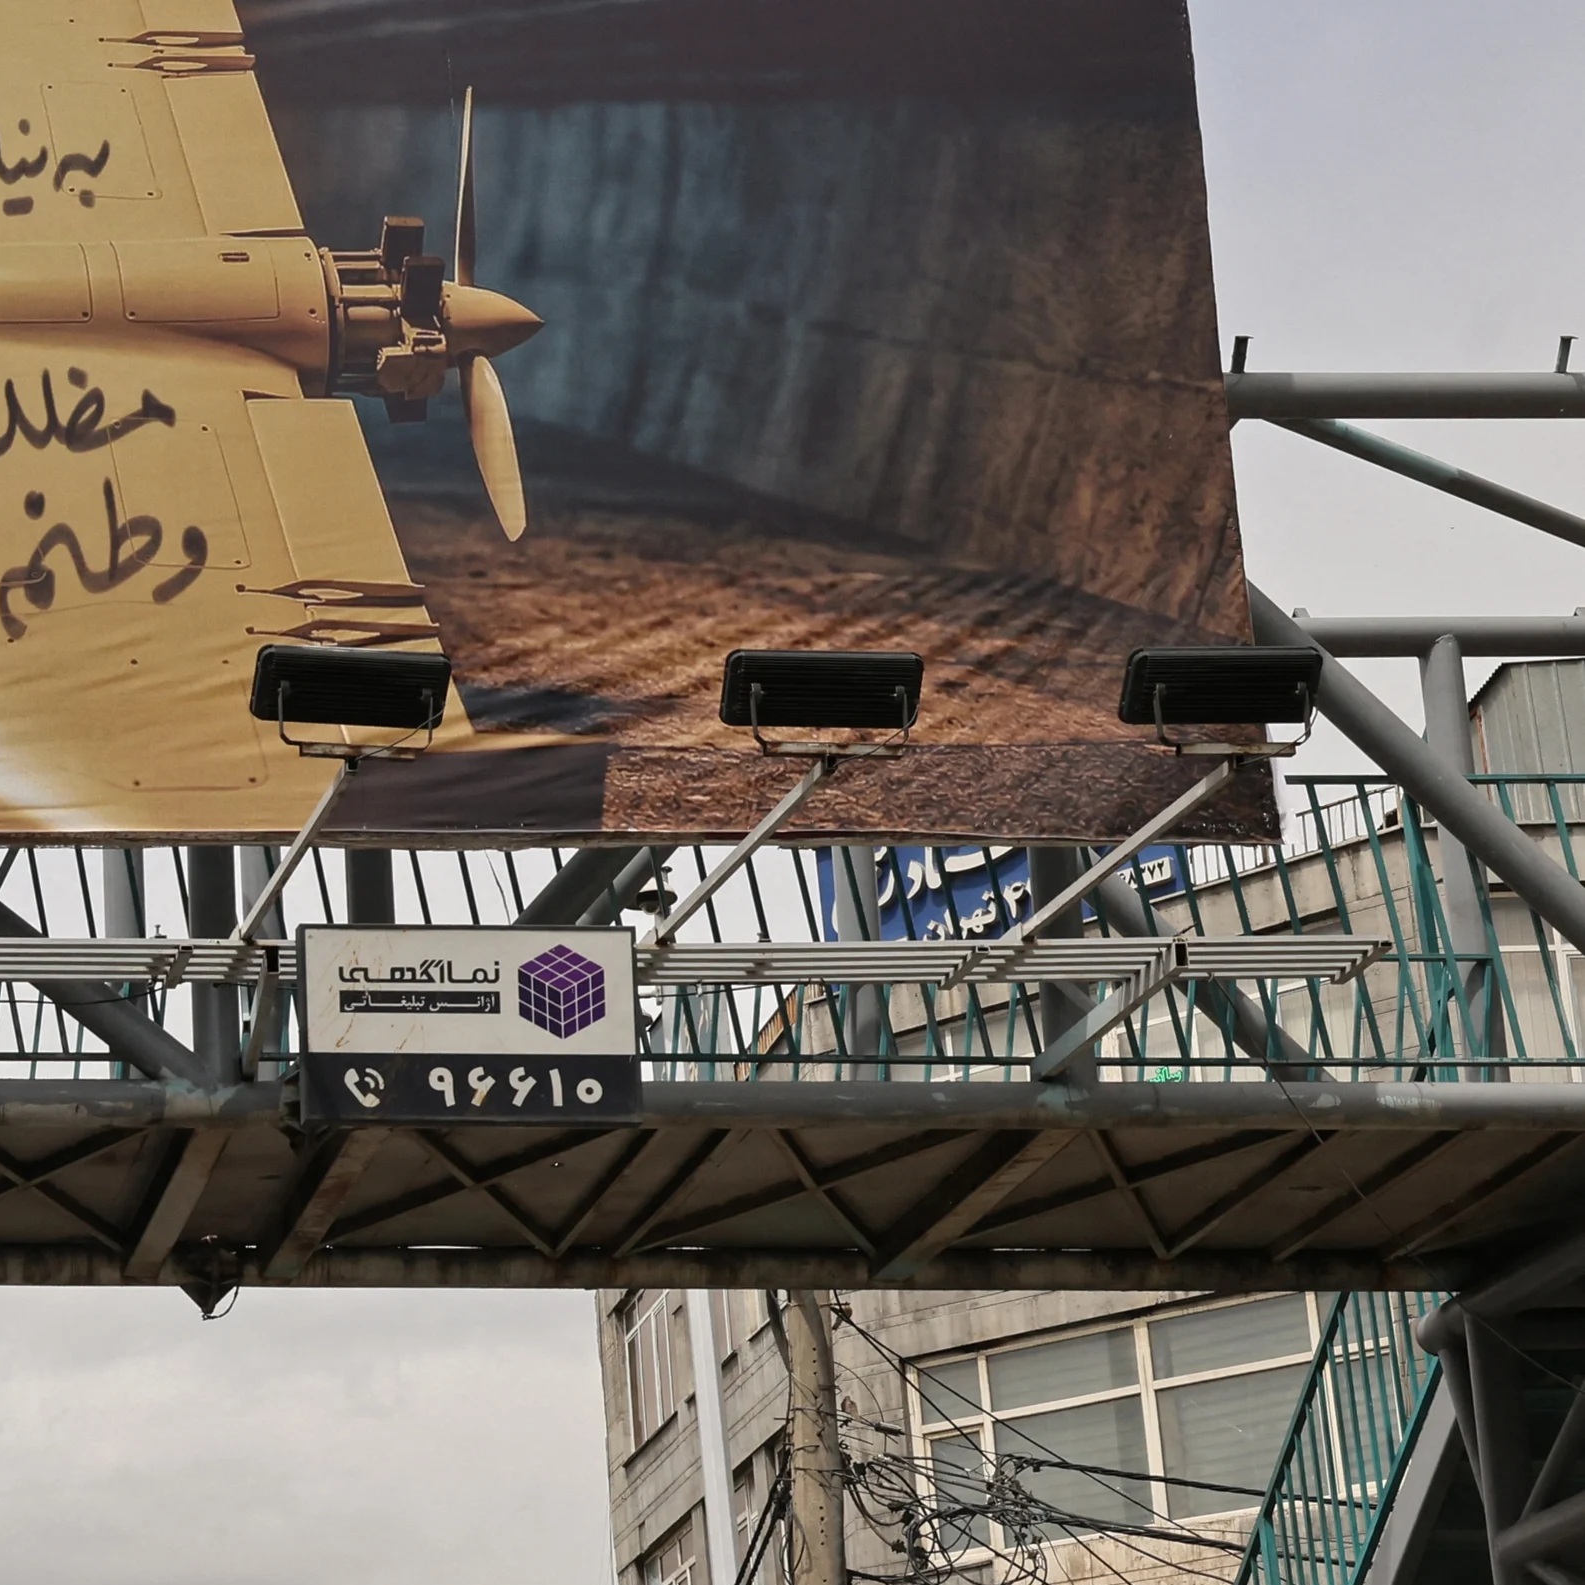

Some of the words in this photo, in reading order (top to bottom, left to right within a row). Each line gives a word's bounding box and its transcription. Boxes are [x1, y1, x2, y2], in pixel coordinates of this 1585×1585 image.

[53, 139, 111, 208] به
[343, 992, 426, 1013] تبلیغاتی
[429, 993, 496, 1012] آژانس
[428, 1066, 604, 1108] ۹۶۶۱۰
